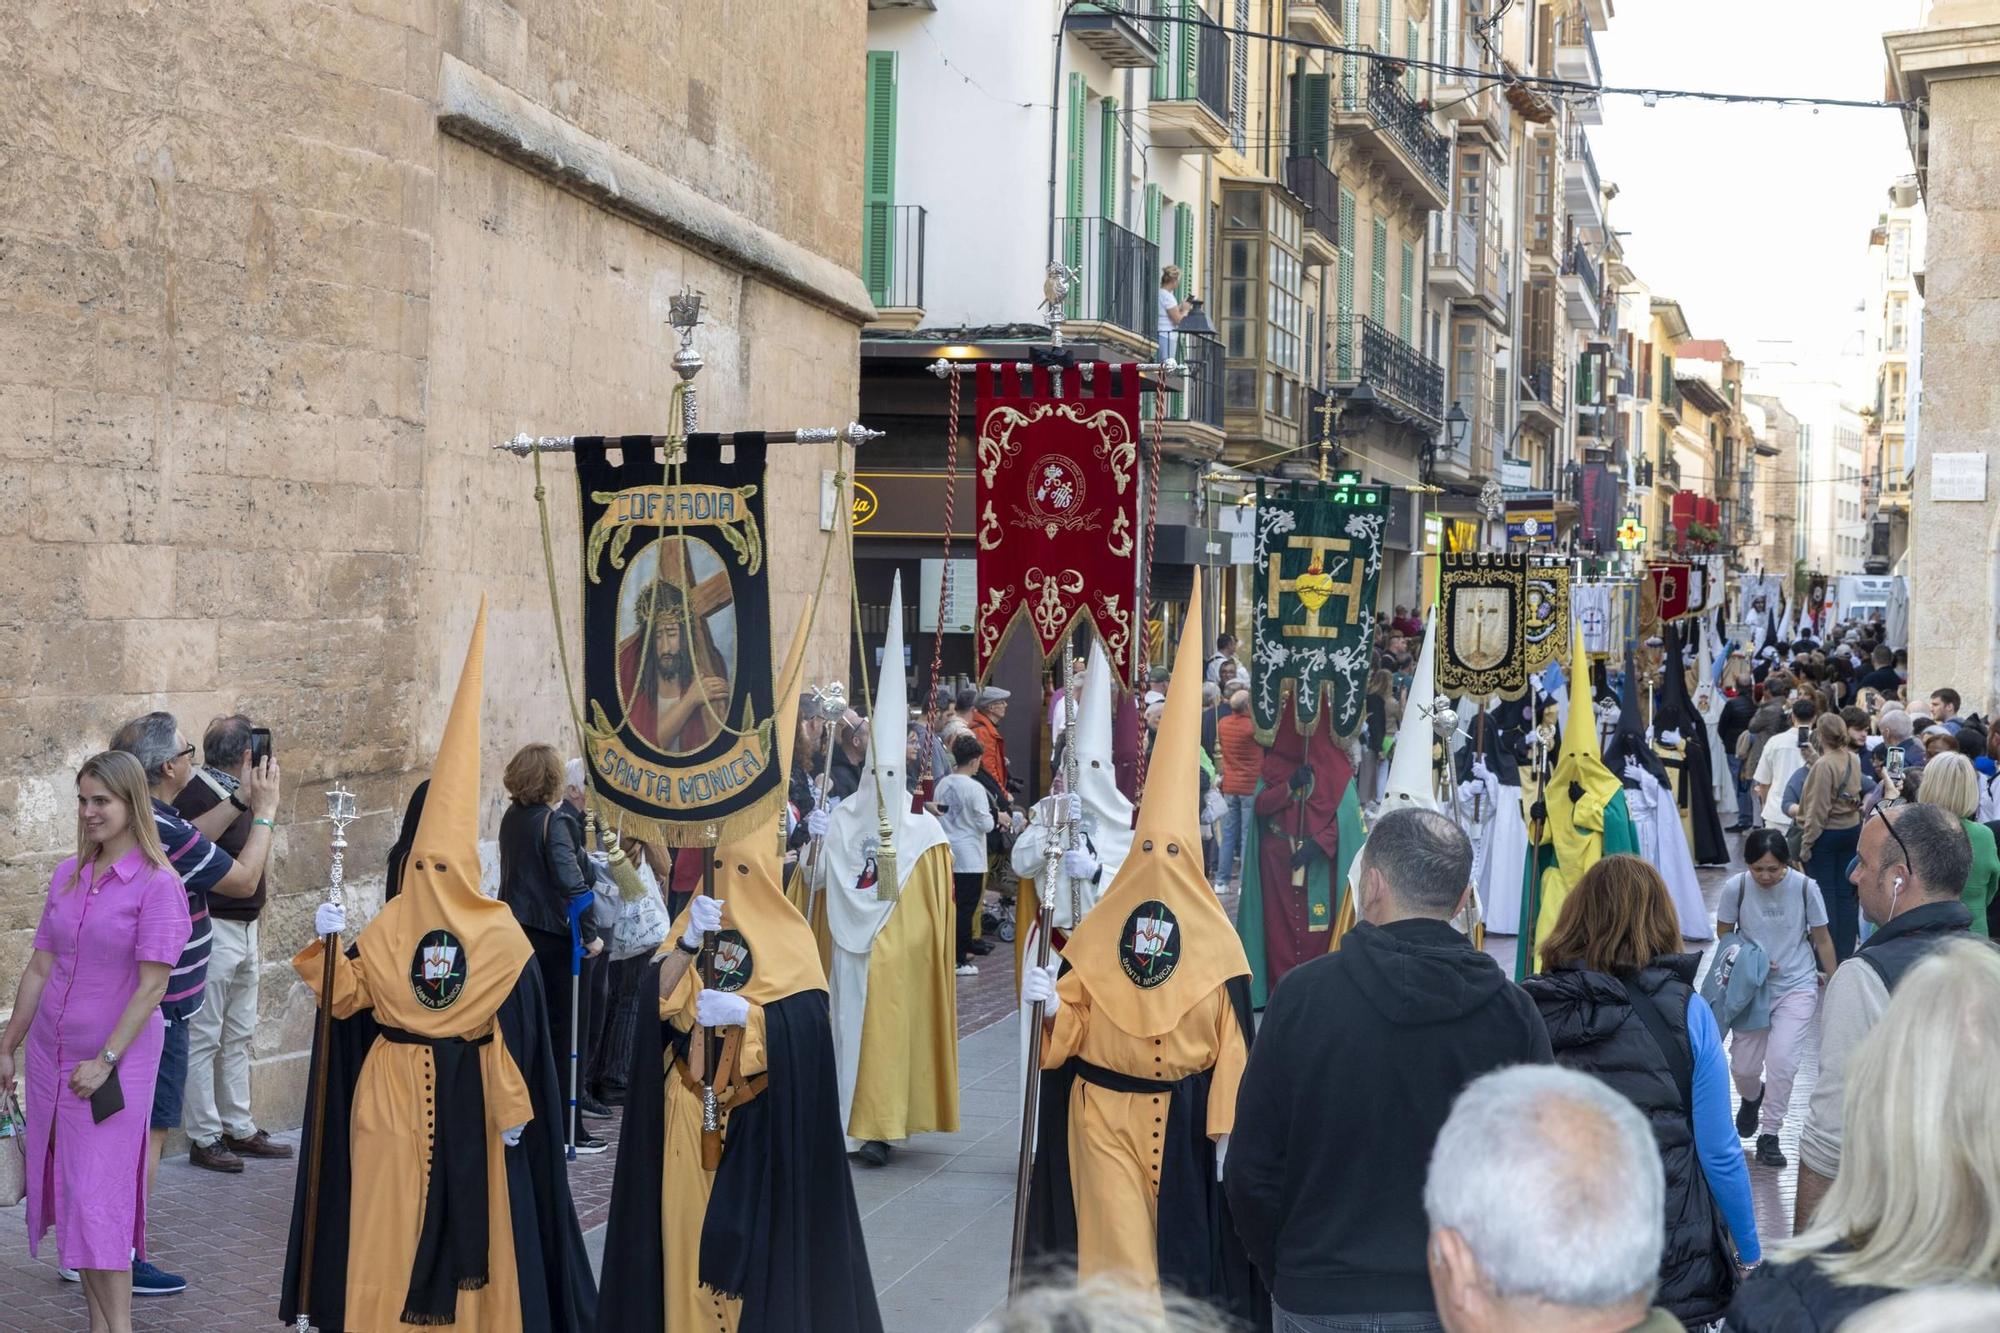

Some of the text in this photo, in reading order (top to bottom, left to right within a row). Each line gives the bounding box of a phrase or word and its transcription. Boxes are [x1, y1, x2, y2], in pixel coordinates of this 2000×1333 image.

[618, 492, 734, 520] COFRADIA
[852, 497, 871, 512] ia
[600, 748, 762, 804] SANTA MONICA
[1122, 957, 1173, 985] SANTA MONICA
[416, 983, 462, 1007] SANTA MONICA
